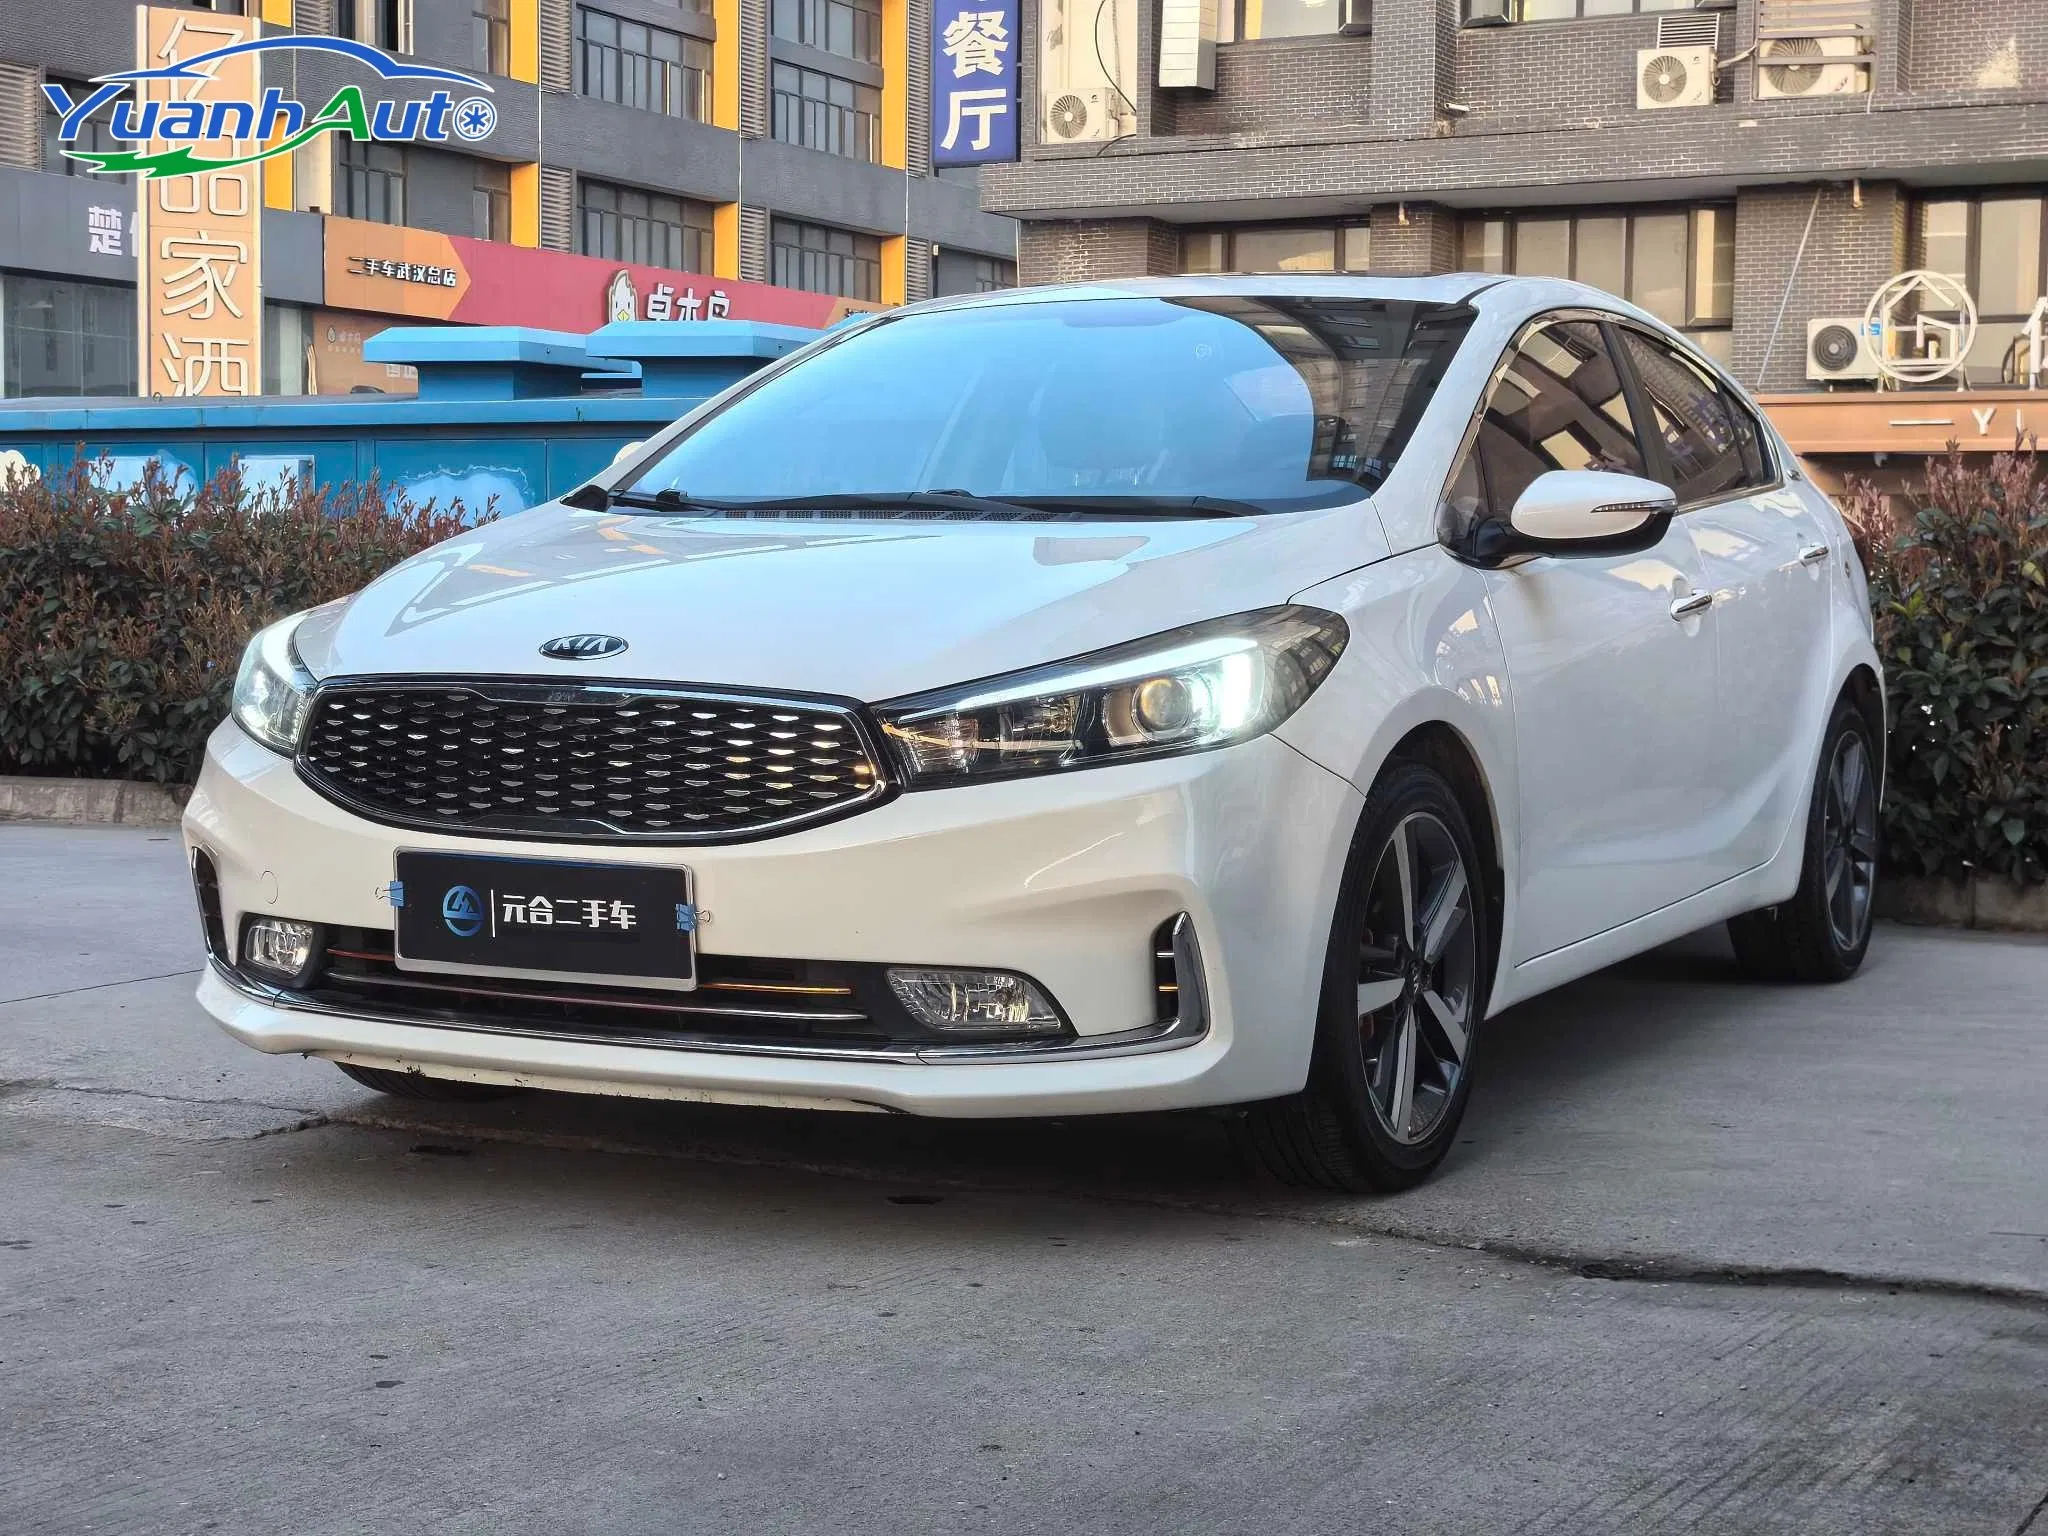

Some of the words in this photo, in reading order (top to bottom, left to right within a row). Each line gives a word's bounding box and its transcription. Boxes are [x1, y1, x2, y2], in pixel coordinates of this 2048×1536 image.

[940, 10, 1009, 151] 餐厅
[88, 206, 138, 258] 楚
[347, 256, 457, 288] 二手车武汉总店
[502, 894, 637, 930] 元合二手车
